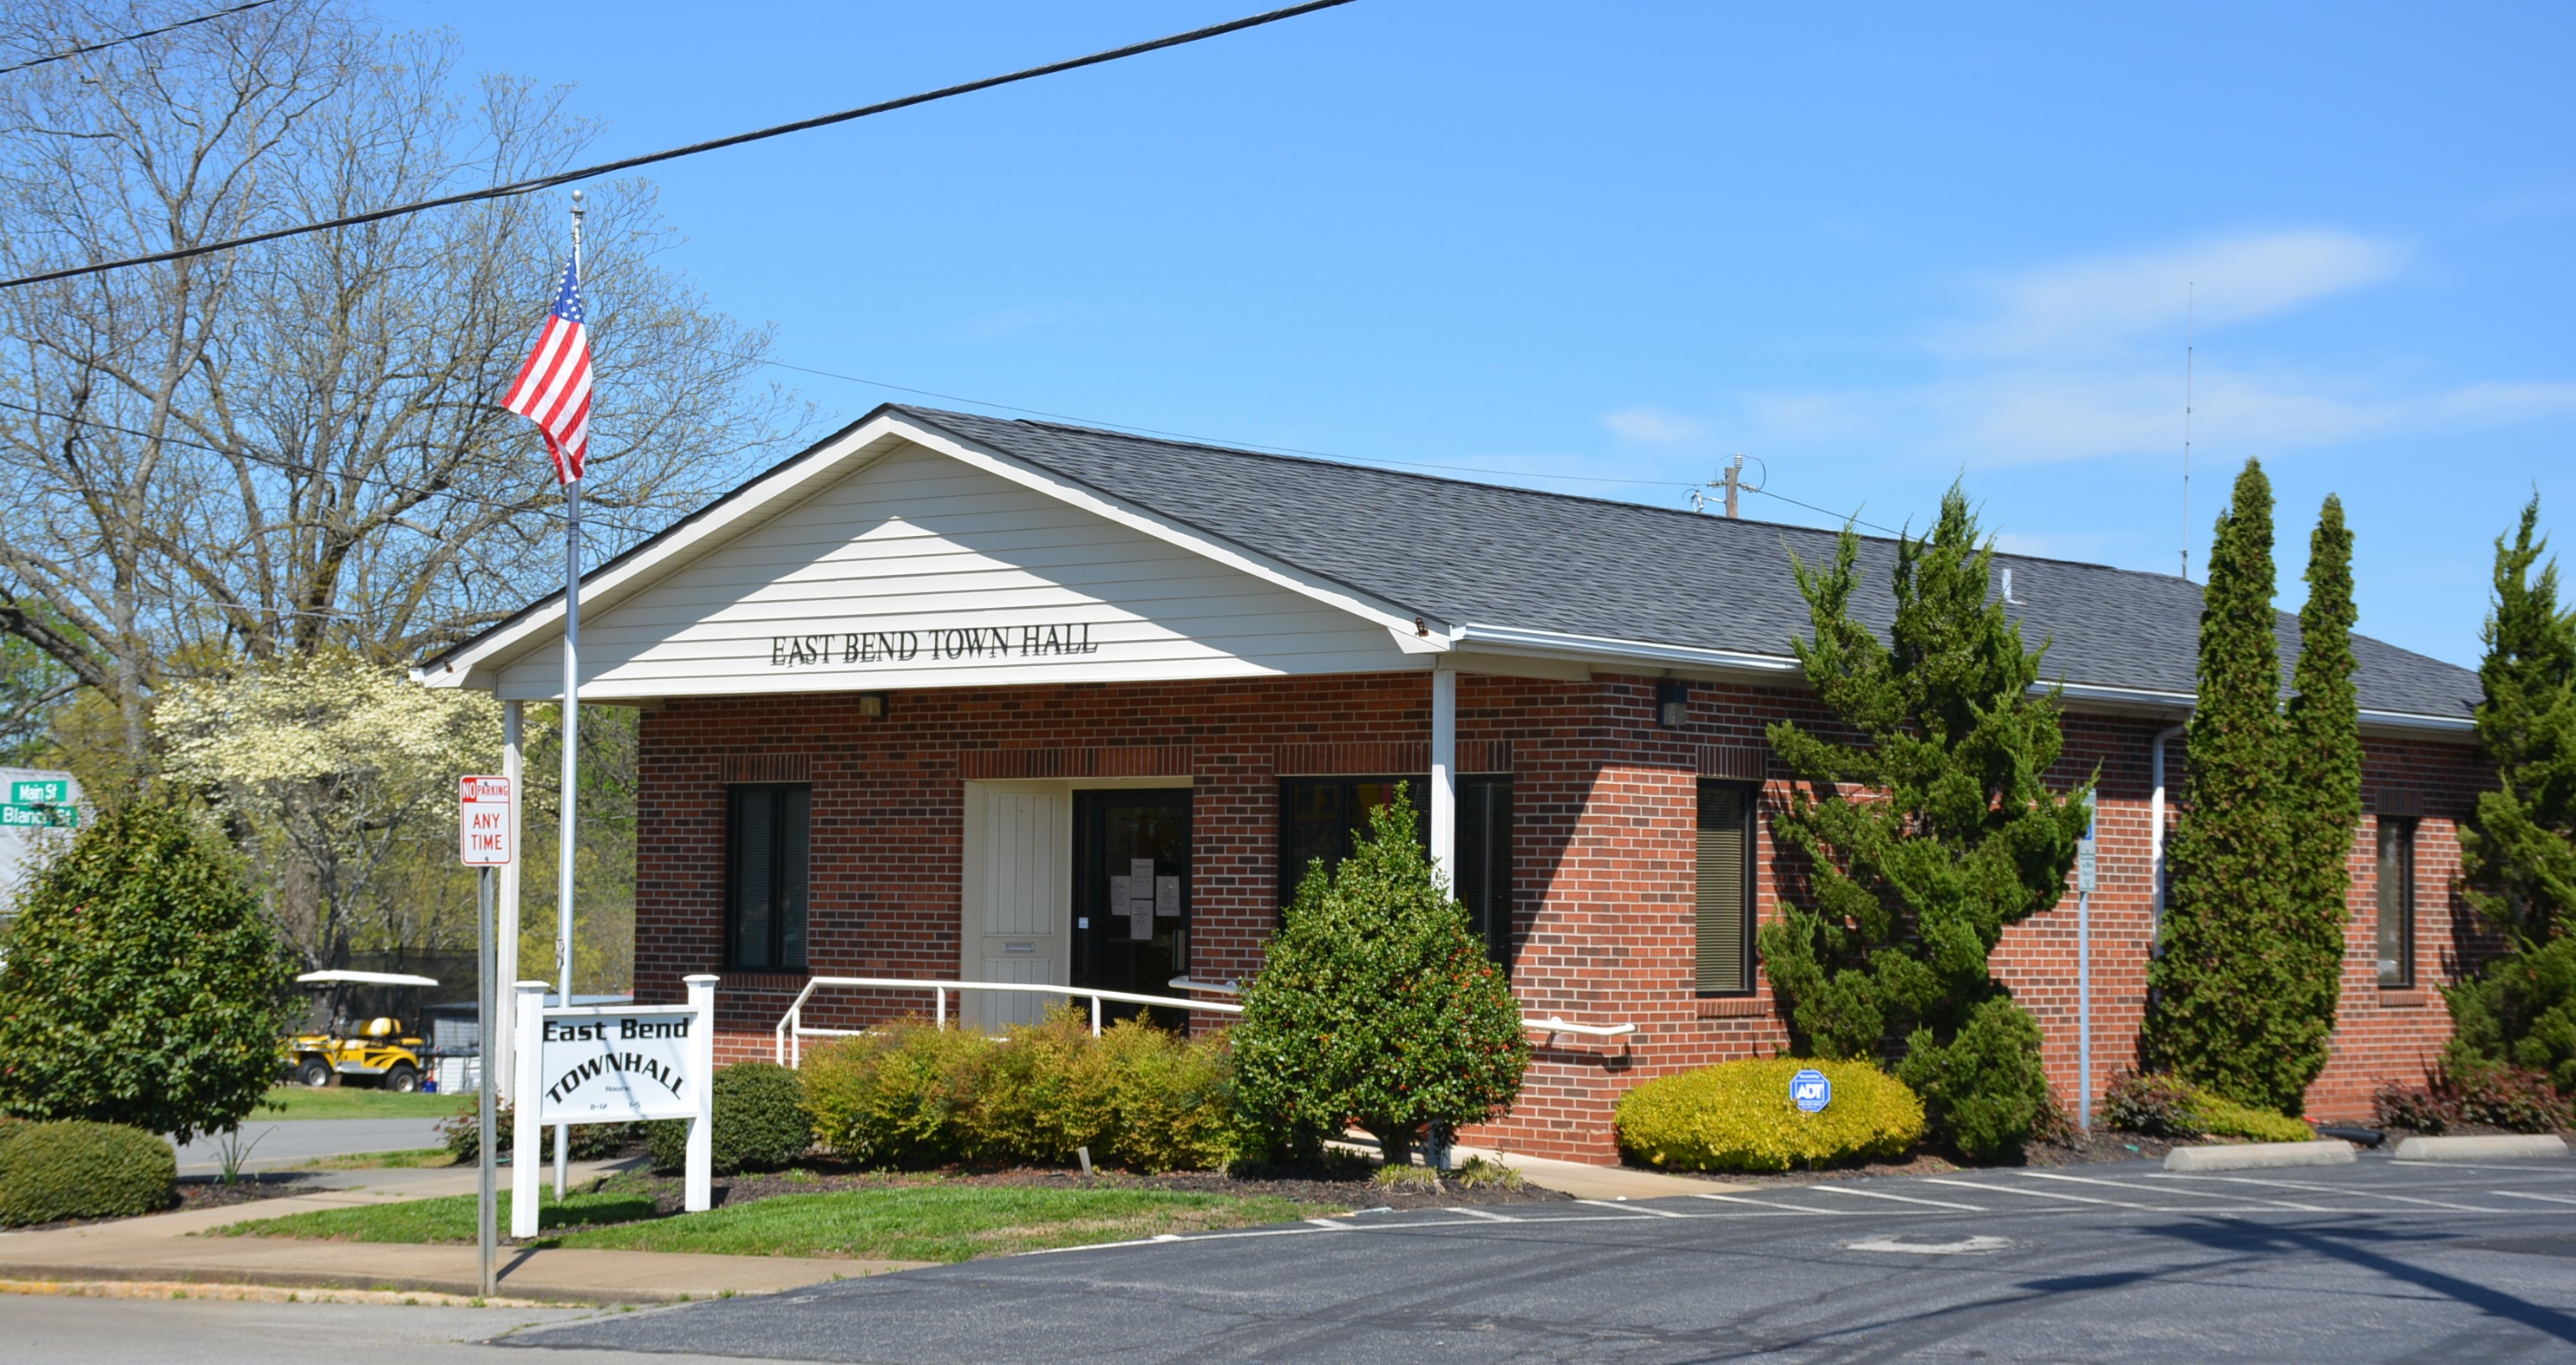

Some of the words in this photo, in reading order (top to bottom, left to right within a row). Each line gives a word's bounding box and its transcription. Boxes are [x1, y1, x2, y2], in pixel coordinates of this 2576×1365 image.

[769, 635, 835, 668] EAST
[843, 630, 918, 663] BEND
[928, 626, 1010, 660] TOWN
[1020, 622, 1099, 657] HALL
[19, 784, 44, 800] Main
[45, 783, 57, 800] St
[463, 781, 476, 799] NO
[477, 785, 508, 796] PARKING
[473, 813, 500, 829] ANY
[471, 834, 502, 850] TIME
[543, 1021, 607, 1042] East
[620, 1017, 690, 1040] Bend
[546, 1052, 683, 1105] TOWNHALL
[1795, 1083, 1824, 1099] ADT
